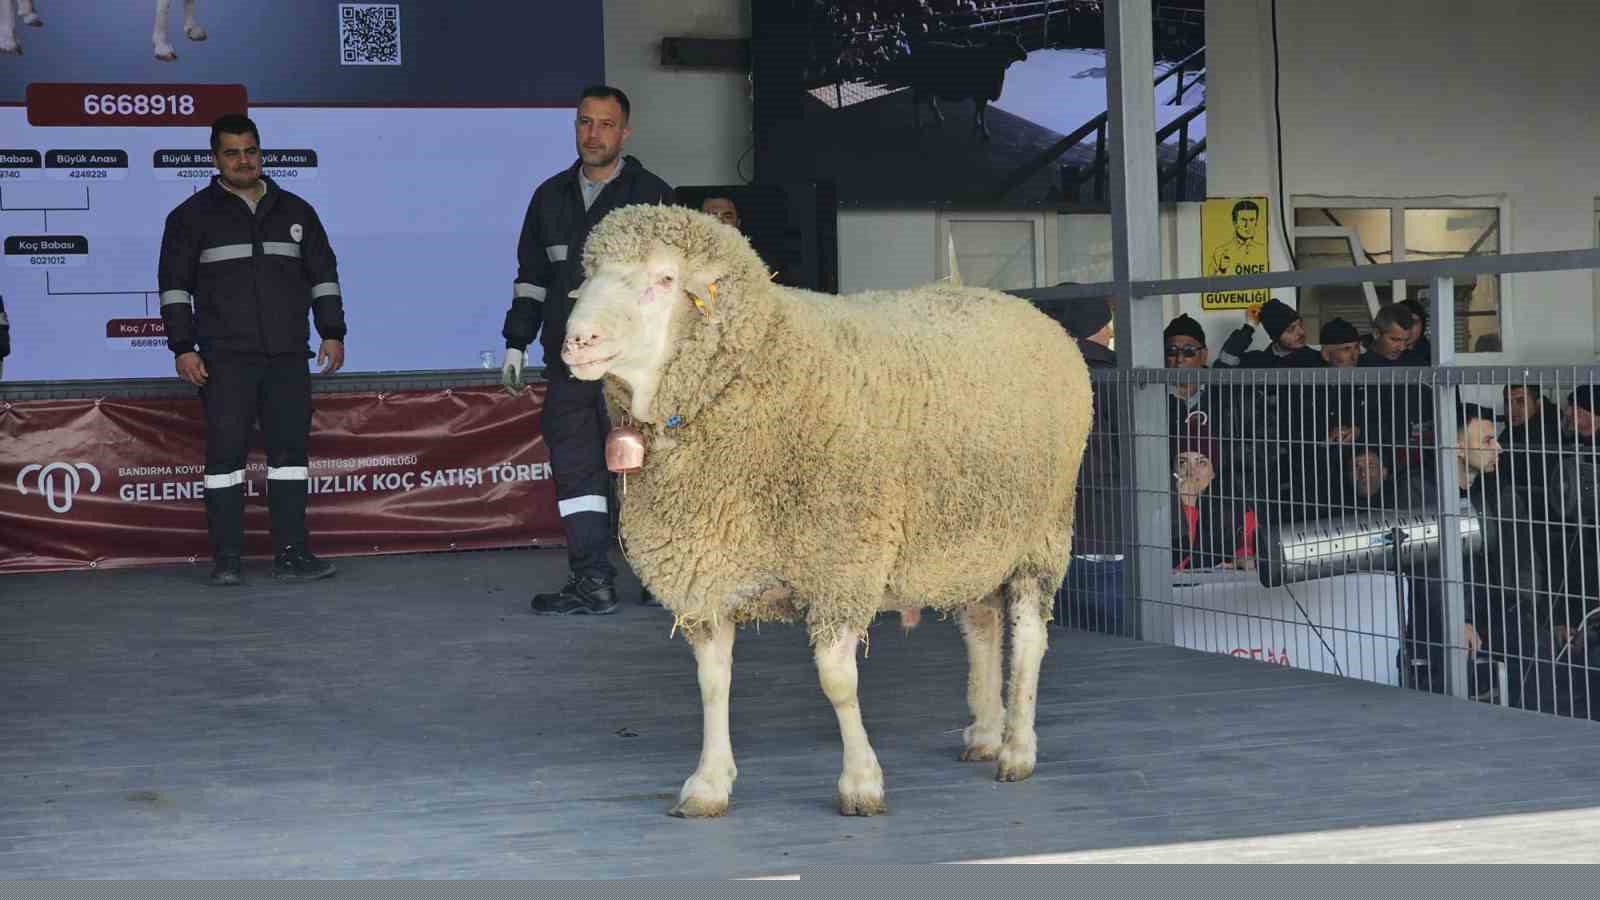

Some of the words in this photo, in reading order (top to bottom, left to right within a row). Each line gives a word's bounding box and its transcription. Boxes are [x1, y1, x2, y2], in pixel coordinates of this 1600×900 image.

[84, 95, 194, 115] 6668918
[56, 153, 87, 164] Büyük
[90, 154, 117, 163] Anası
[162, 153, 191, 164] Büyük
[281, 153, 308, 163] Anası
[19, 240, 38, 251] Koç
[41, 240, 75, 249] Babası
[120, 324, 138, 334] Koç
[118, 464, 172, 477] BANDIRMA
[372, 471, 416, 492] KOÇ
[420, 467, 483, 489] SATIŞI
